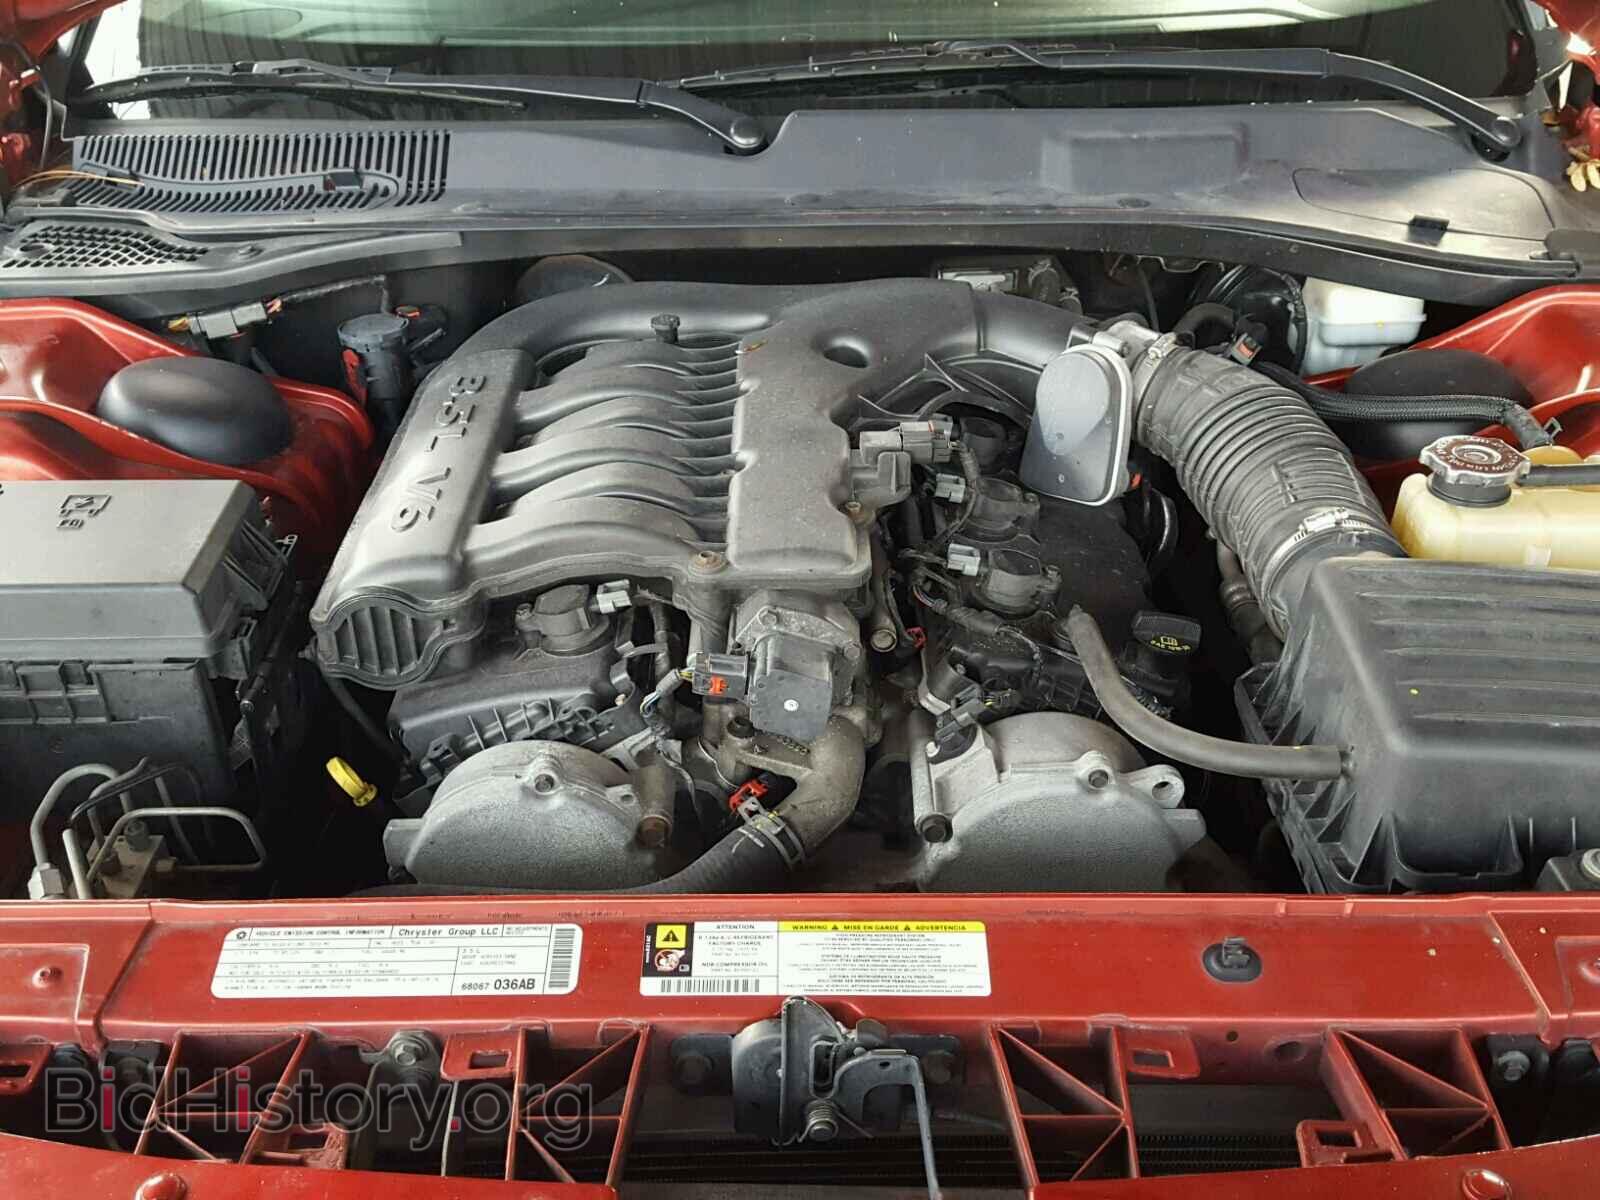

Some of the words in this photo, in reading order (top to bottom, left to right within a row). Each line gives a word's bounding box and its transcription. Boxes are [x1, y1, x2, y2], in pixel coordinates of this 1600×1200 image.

[421, 376, 487, 452] 3.5L
[391, 467, 452, 533] V6
[399, 928, 442, 938] Chrysler
[448, 928, 476, 937] Group
[481, 927, 499, 935] LLC
[494, 978, 536, 991] 036AB
